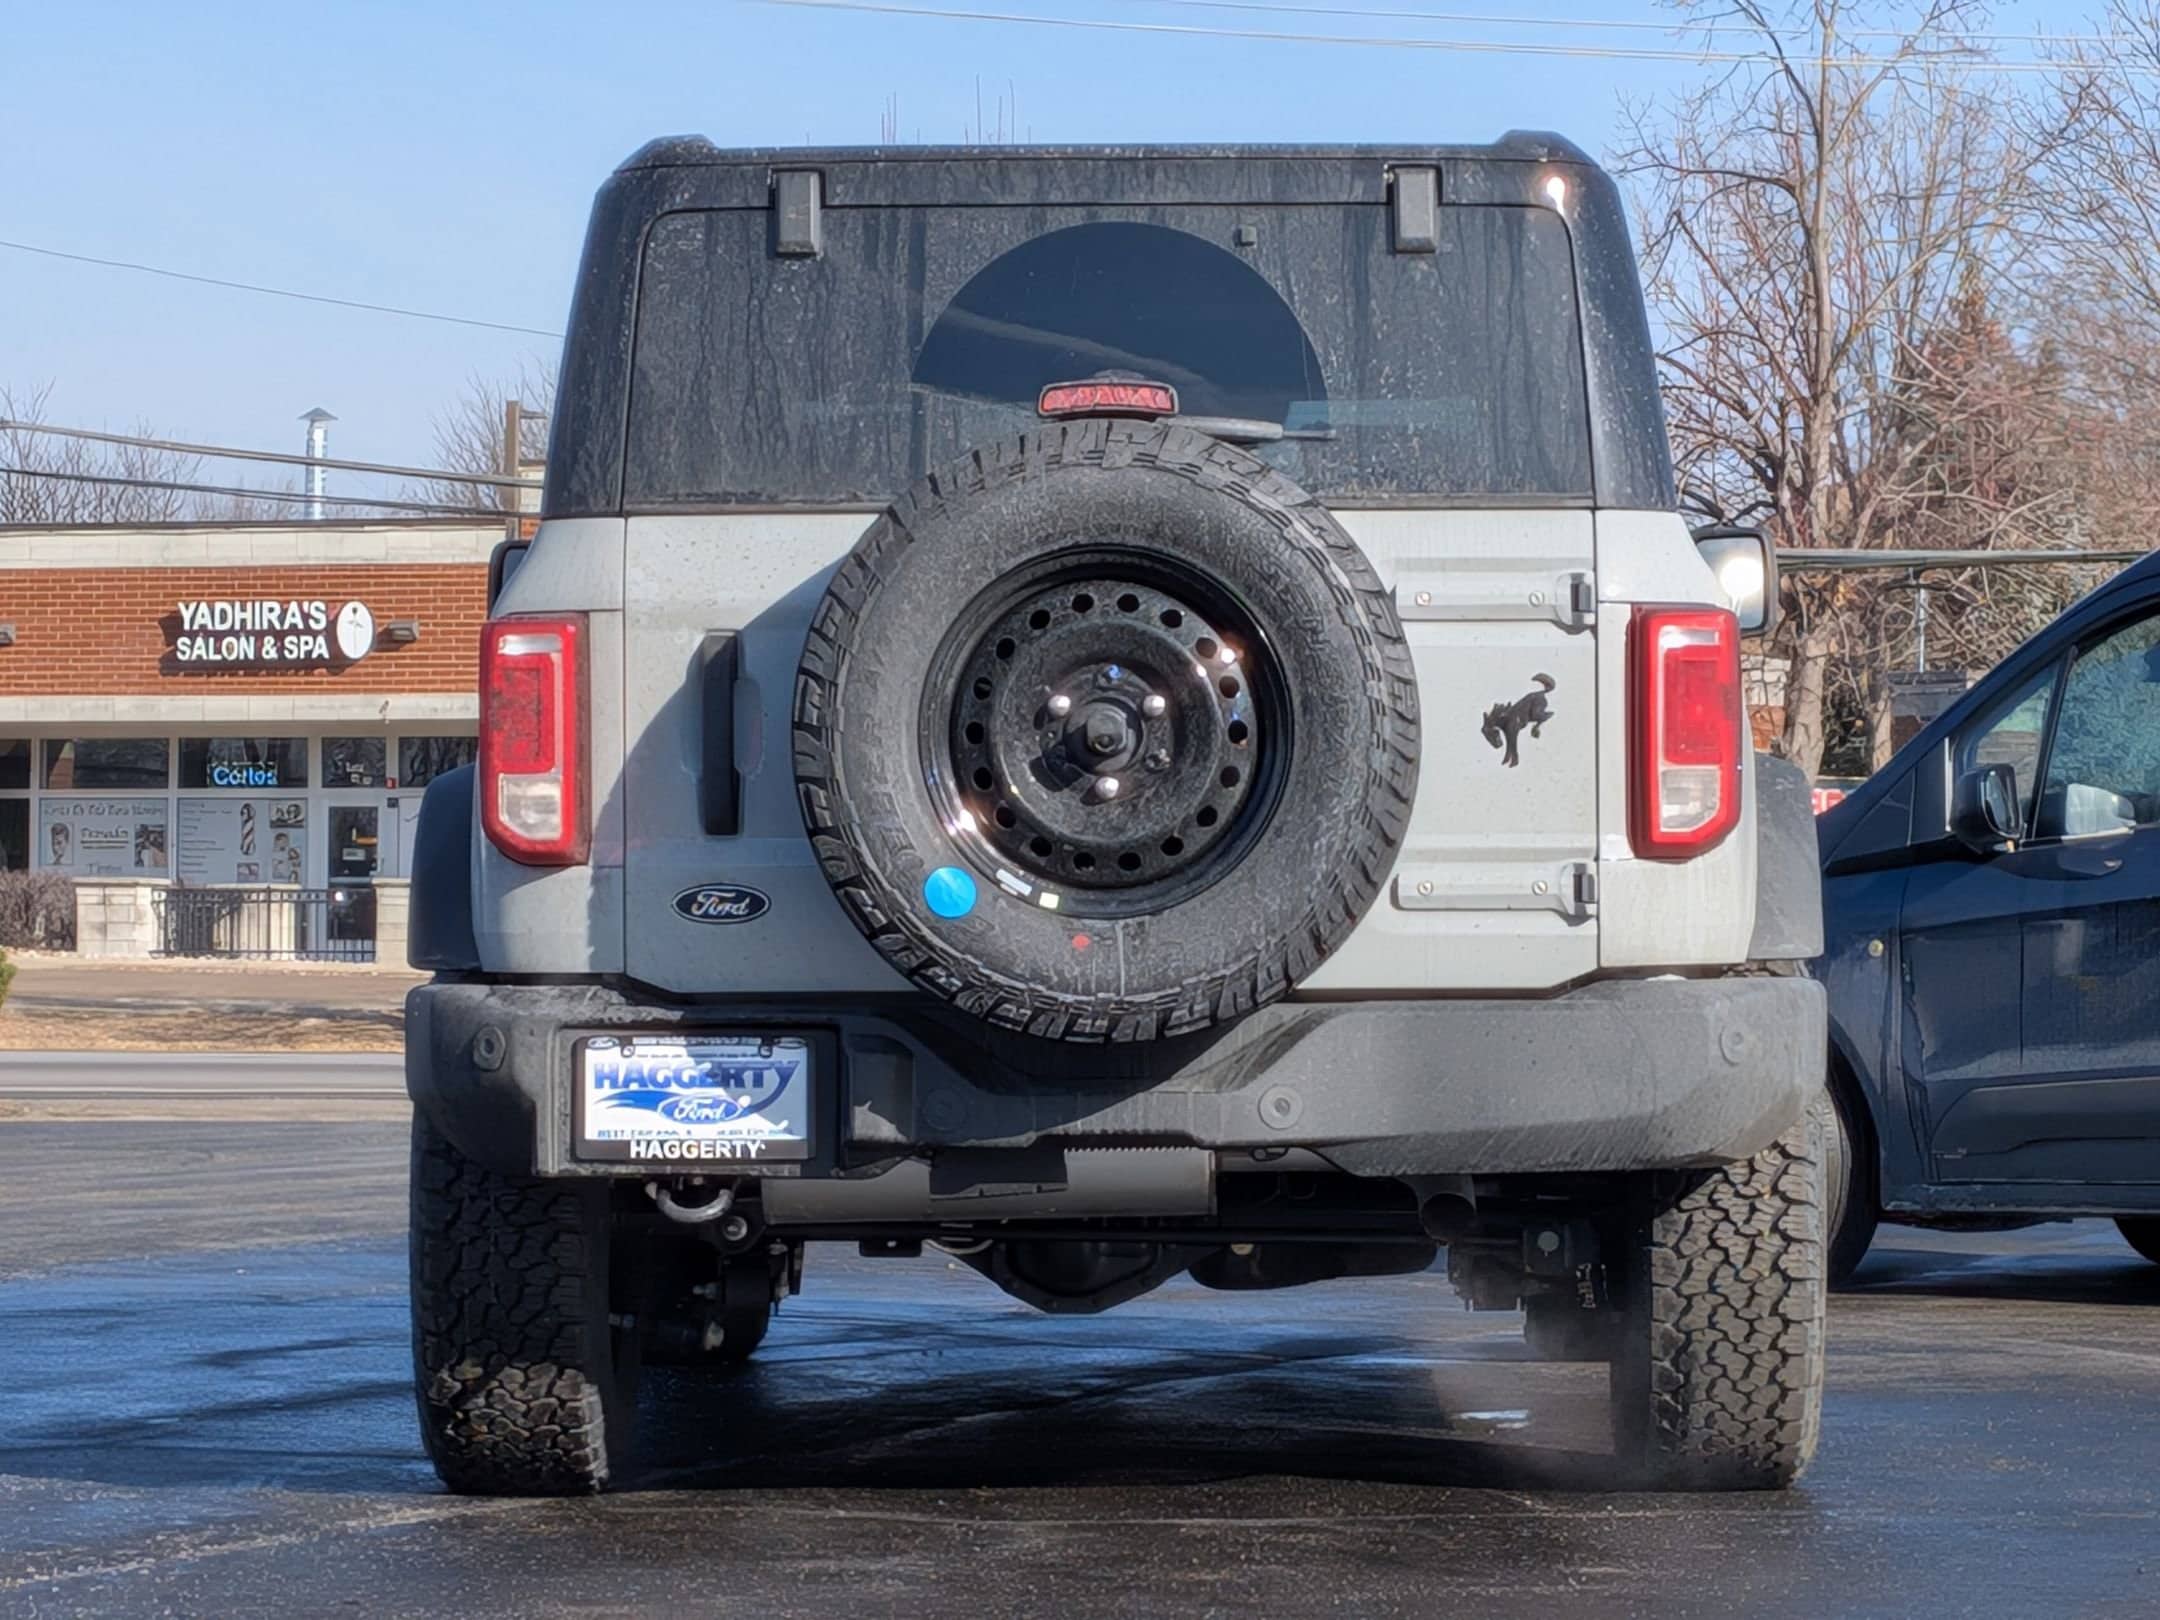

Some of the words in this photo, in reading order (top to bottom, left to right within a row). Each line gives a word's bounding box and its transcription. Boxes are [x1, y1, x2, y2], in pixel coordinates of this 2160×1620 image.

[178, 601, 327, 631] YADHIRA'S
[176, 636, 256, 661] SALON
[261, 636, 279, 660] &
[283, 636, 330, 660] SPA
[691, 890, 751, 916] Ford
[594, 1060, 800, 1094] HAGGERTY
[673, 1097, 728, 1121] Ford
[630, 1140, 759, 1159] HAGGERTY
